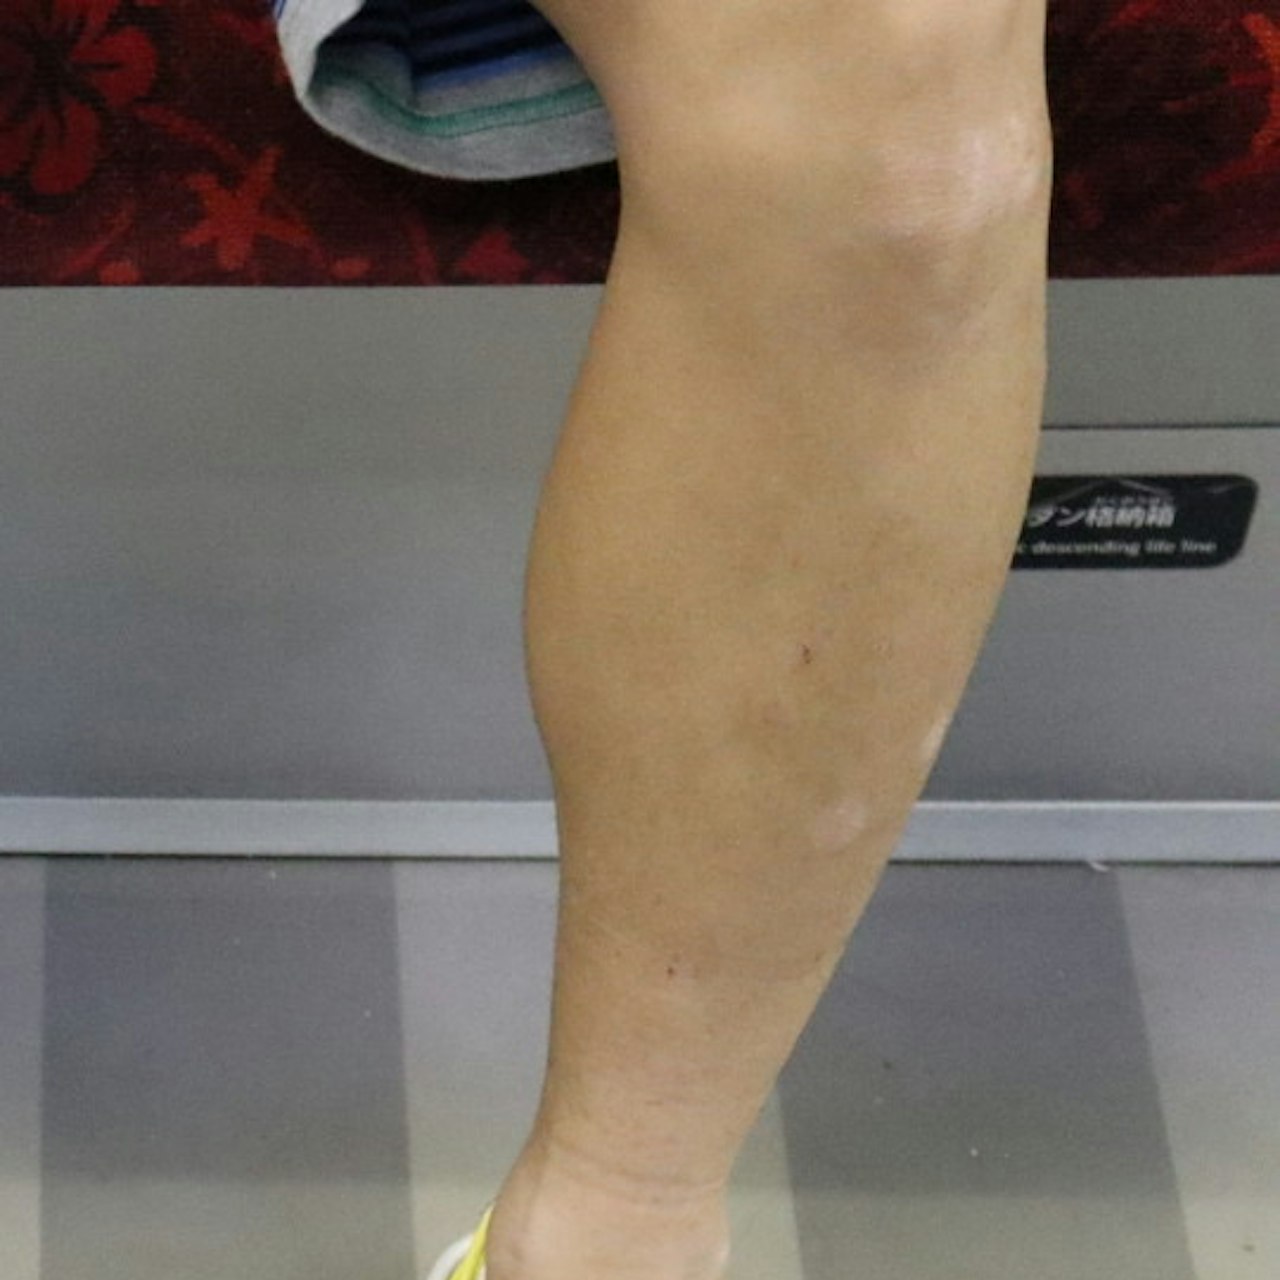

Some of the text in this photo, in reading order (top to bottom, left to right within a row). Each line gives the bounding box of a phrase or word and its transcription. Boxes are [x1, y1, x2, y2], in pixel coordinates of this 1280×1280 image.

[1033, 541, 1140, 557] descending
[1146, 539, 1176, 554] life
[1181, 539, 1217, 554] line
